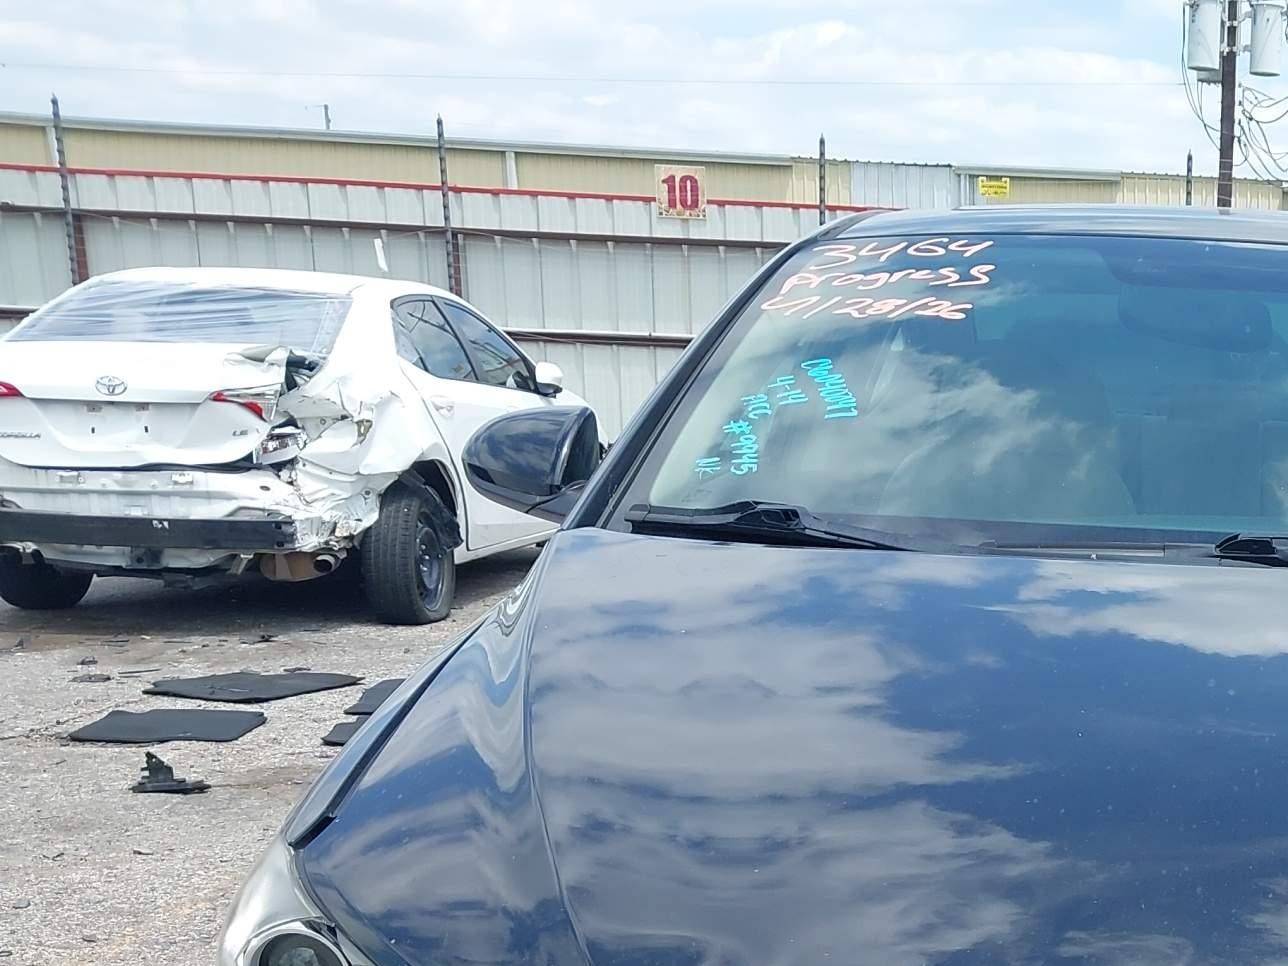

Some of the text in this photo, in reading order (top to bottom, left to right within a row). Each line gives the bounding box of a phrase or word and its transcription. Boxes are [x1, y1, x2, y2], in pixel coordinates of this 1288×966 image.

[661, 174, 699, 210] 10
[809, 237, 994, 270] 3464
[760, 296, 974, 320] 4/28/26
